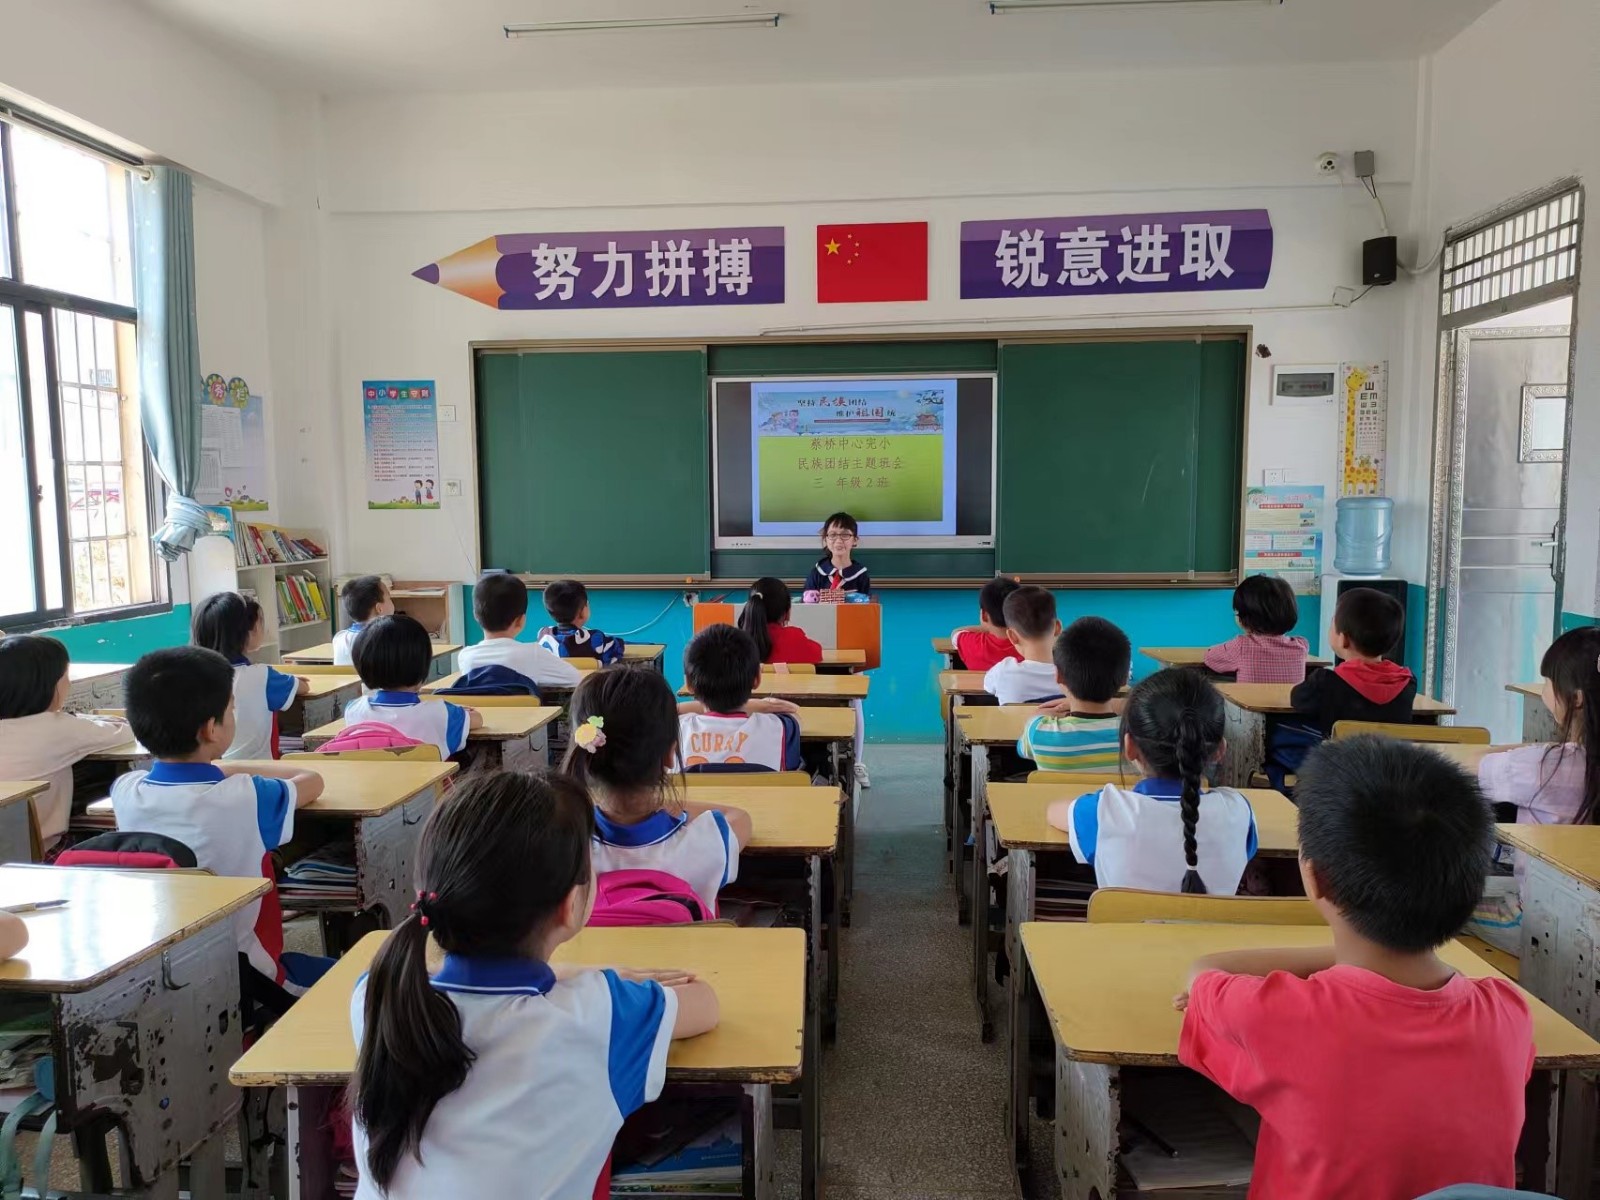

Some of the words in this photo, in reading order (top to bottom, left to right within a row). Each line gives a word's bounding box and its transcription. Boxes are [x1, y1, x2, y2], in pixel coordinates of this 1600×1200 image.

[531, 238, 753, 301] 努力拼搏
[995, 223, 1234, 289] 锐意进取
[811, 437, 891, 450] 蔡桥中心完小
[798, 457, 903, 470] 民族团结主题班会
